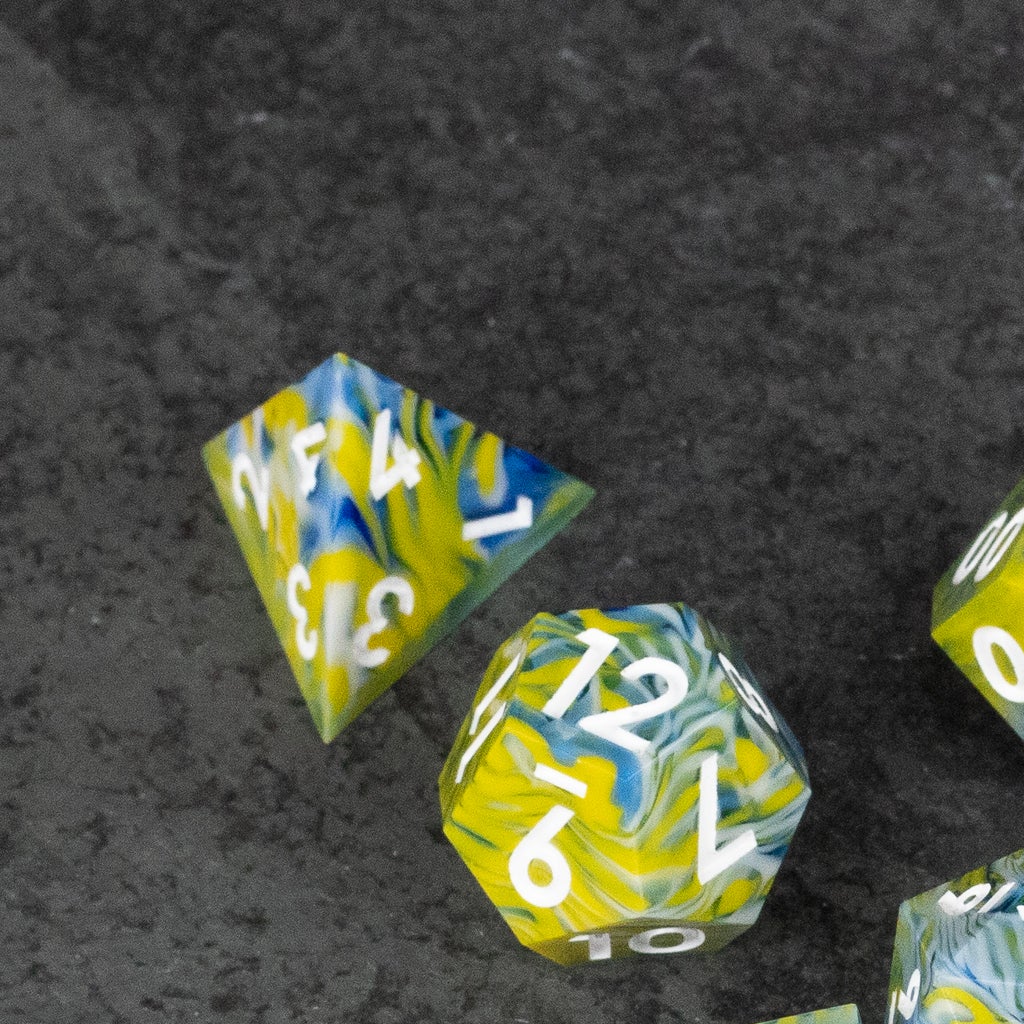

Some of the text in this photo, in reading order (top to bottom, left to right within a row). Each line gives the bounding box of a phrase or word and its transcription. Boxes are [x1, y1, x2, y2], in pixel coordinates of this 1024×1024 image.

[232, 452, 270, 532] 2
[462, 495, 534, 542] 1
[287, 564, 318, 661] 3
[353, 576, 415, 668] 3
[542, 628, 688, 752] 12
[698, 753, 758, 885] 7
[568, 927, 706, 961] 10
